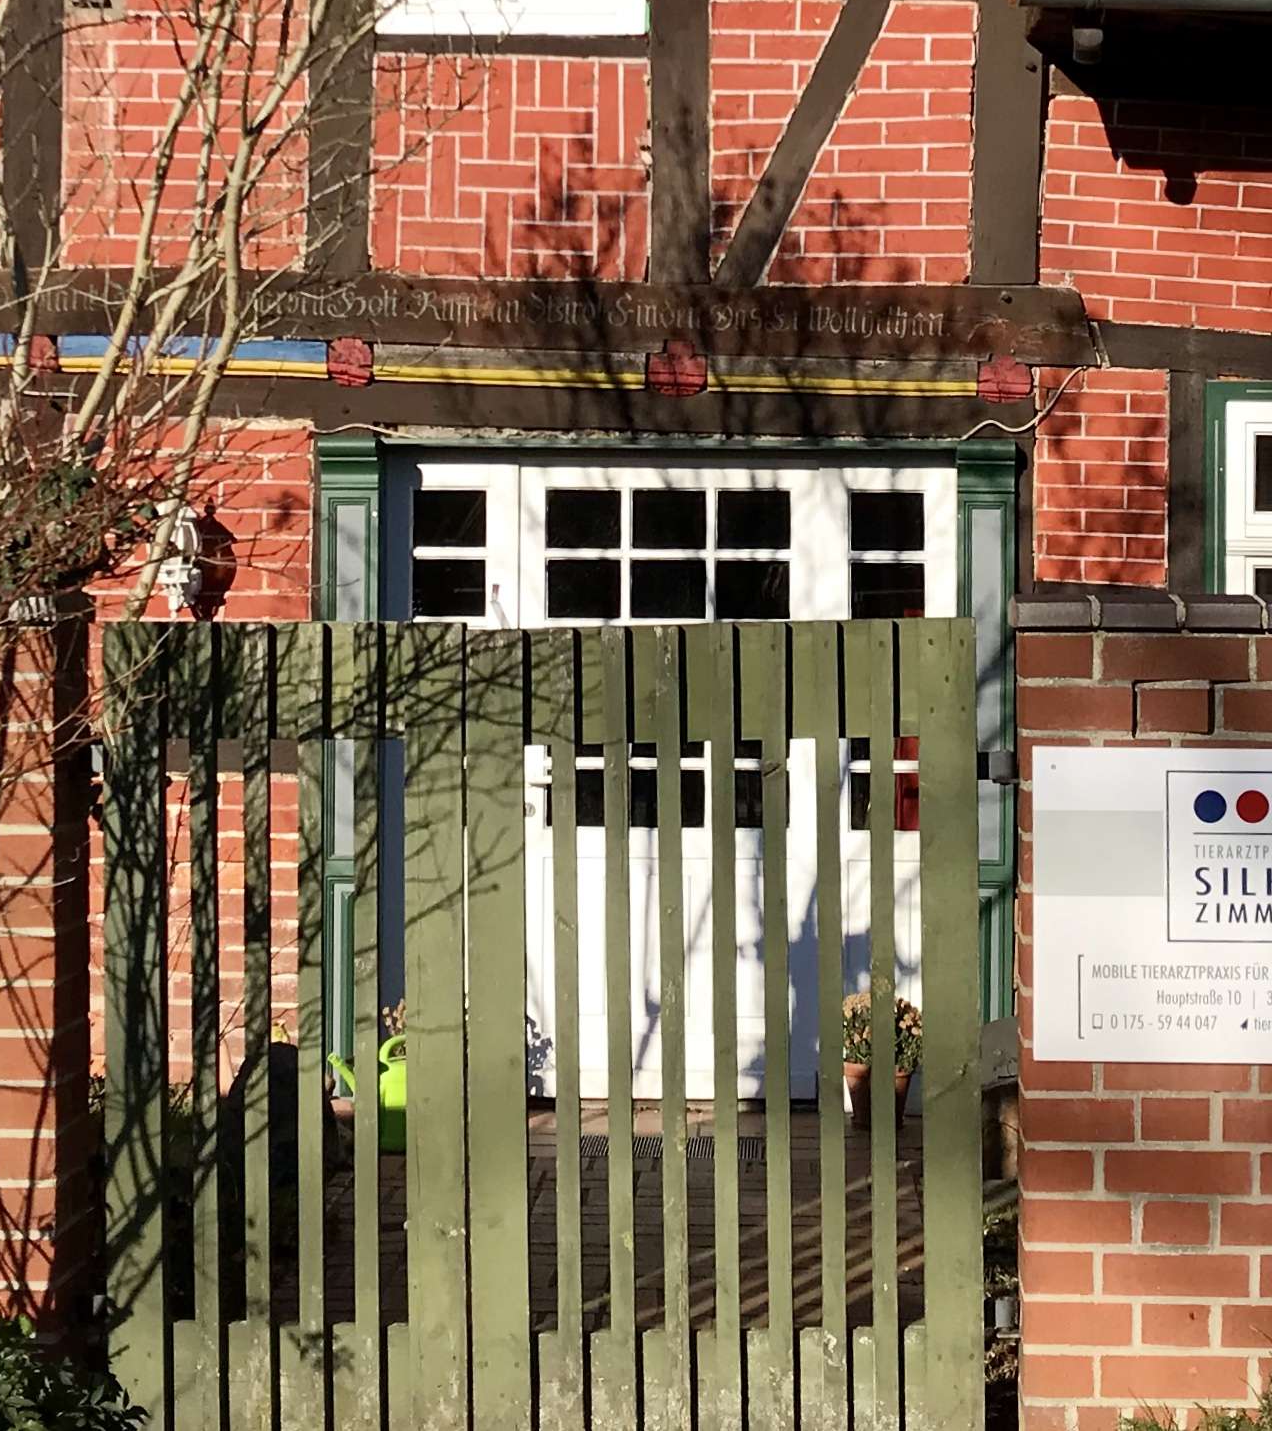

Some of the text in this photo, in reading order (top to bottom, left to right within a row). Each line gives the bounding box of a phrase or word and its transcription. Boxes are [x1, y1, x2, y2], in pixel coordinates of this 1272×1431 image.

[1091, 964, 1138, 980] MOBILE
[1141, 964, 1241, 981] TIERARZTPRAXIS
[1244, 961, 1269, 982] FÜR
[1156, 989, 1224, 1008] Hauptstraße
[1227, 989, 1242, 1006] 10
[1110, 1013, 1119, 1030] 0
[1123, 1013, 1145, 1031] 175
[1157, 1015, 1173, 1031] 59
[1175, 1015, 1191, 1031] 44
[1194, 1015, 1218, 1032] 047
